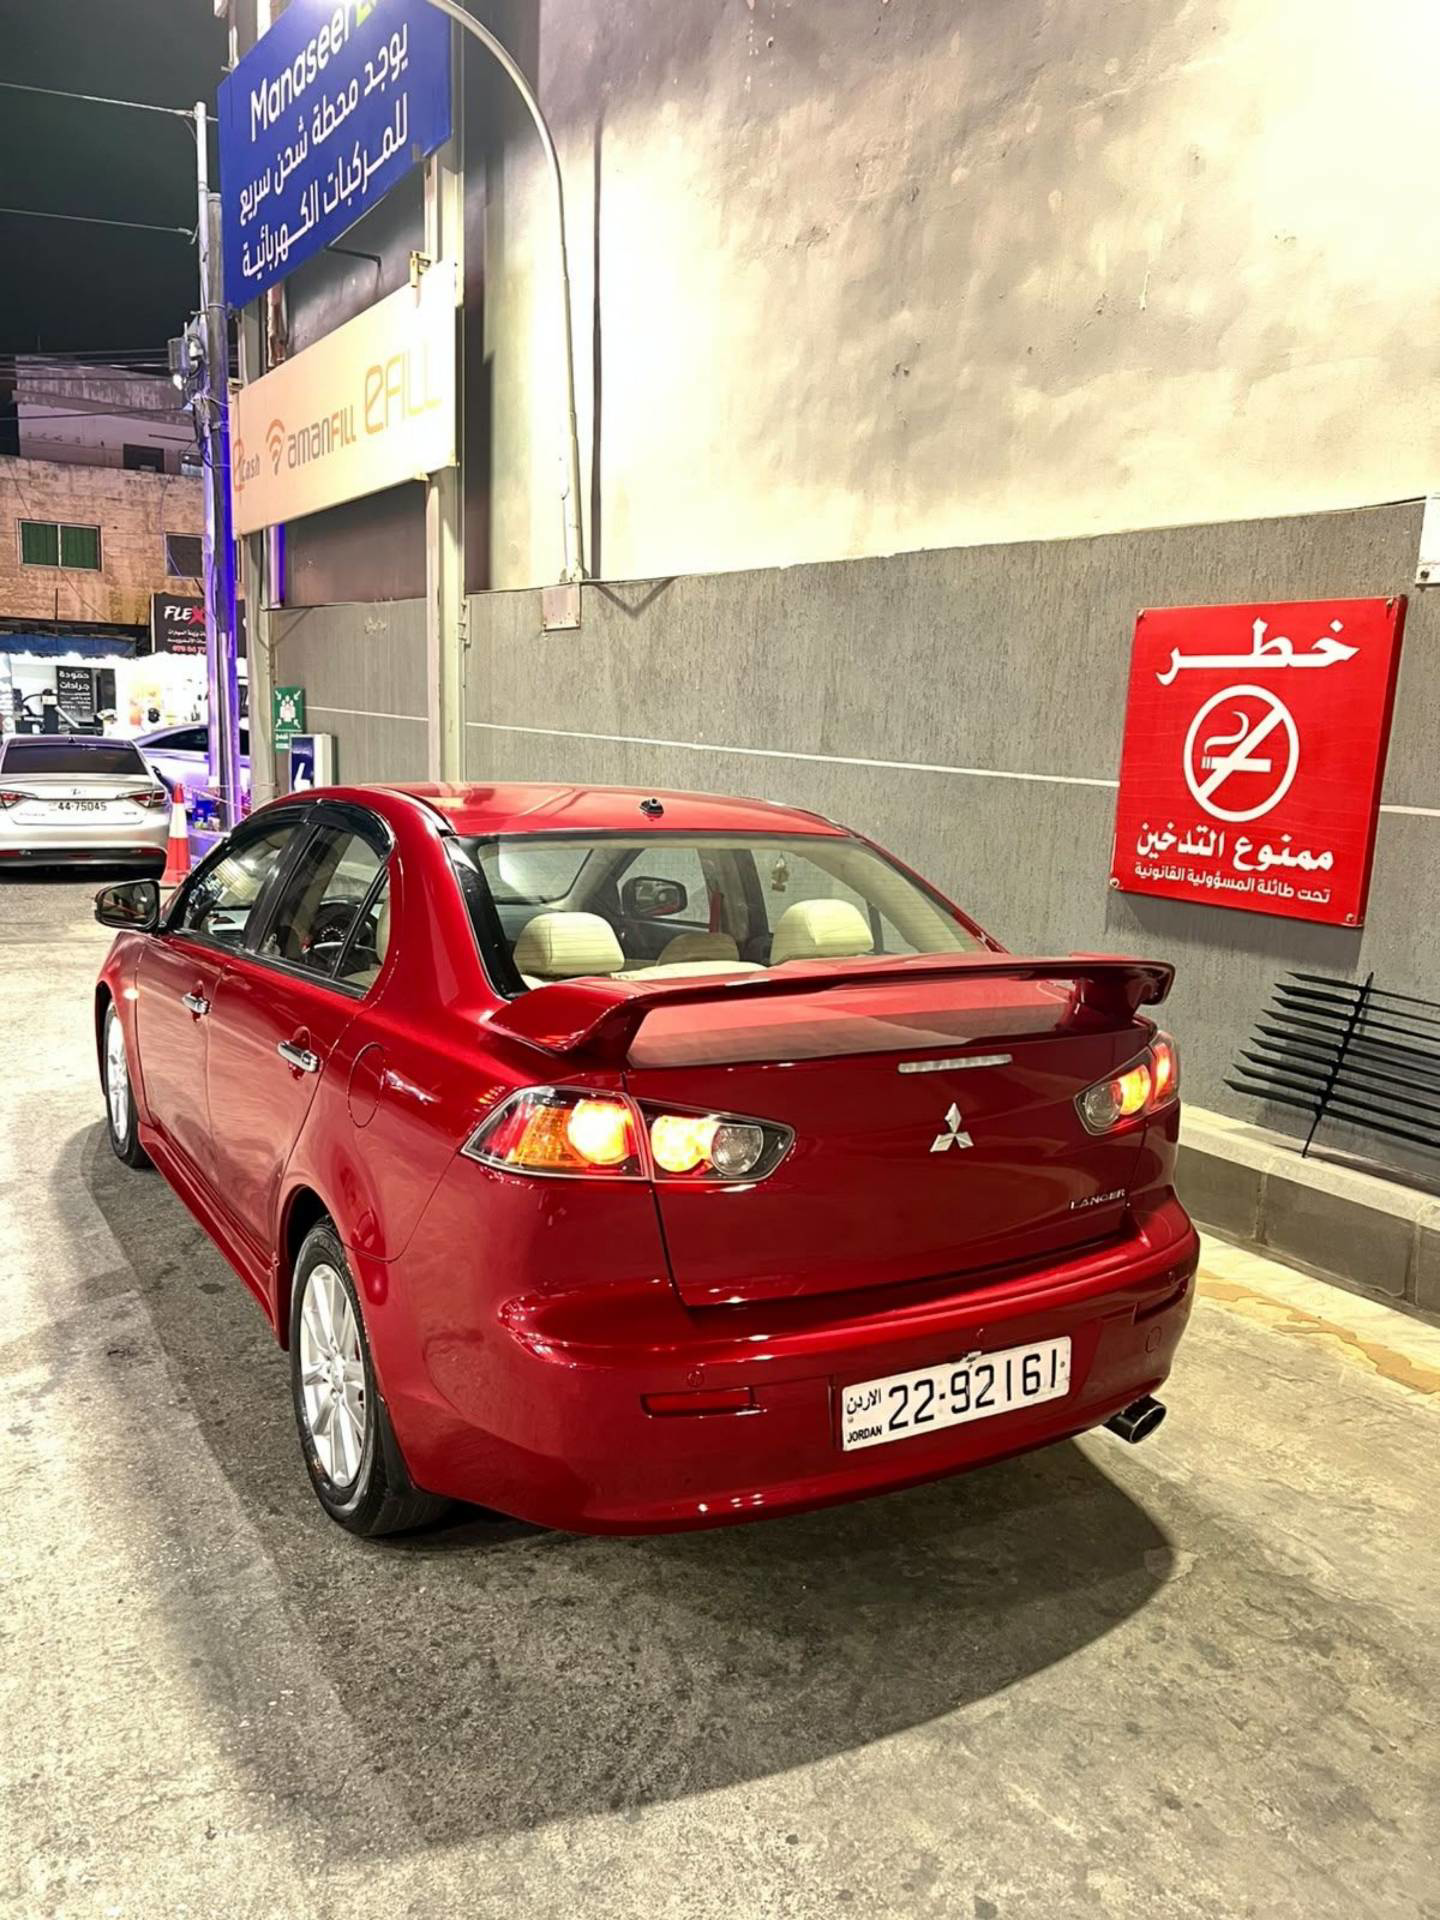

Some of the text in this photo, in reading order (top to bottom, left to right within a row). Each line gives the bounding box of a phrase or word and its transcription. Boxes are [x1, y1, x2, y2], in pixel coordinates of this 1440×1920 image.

[239, 23, 408, 226] يوجد محطة شحن سريع
[1156, 617, 1360, 686] خطر
[1136, 822, 1334, 872] ممنوع التدخين
[1134, 862, 1331, 903] تحت طائلة المسؤولية القانونية
[1070, 1188, 1126, 1210] LANCER
[847, 1425, 883, 1443] JORDAN
